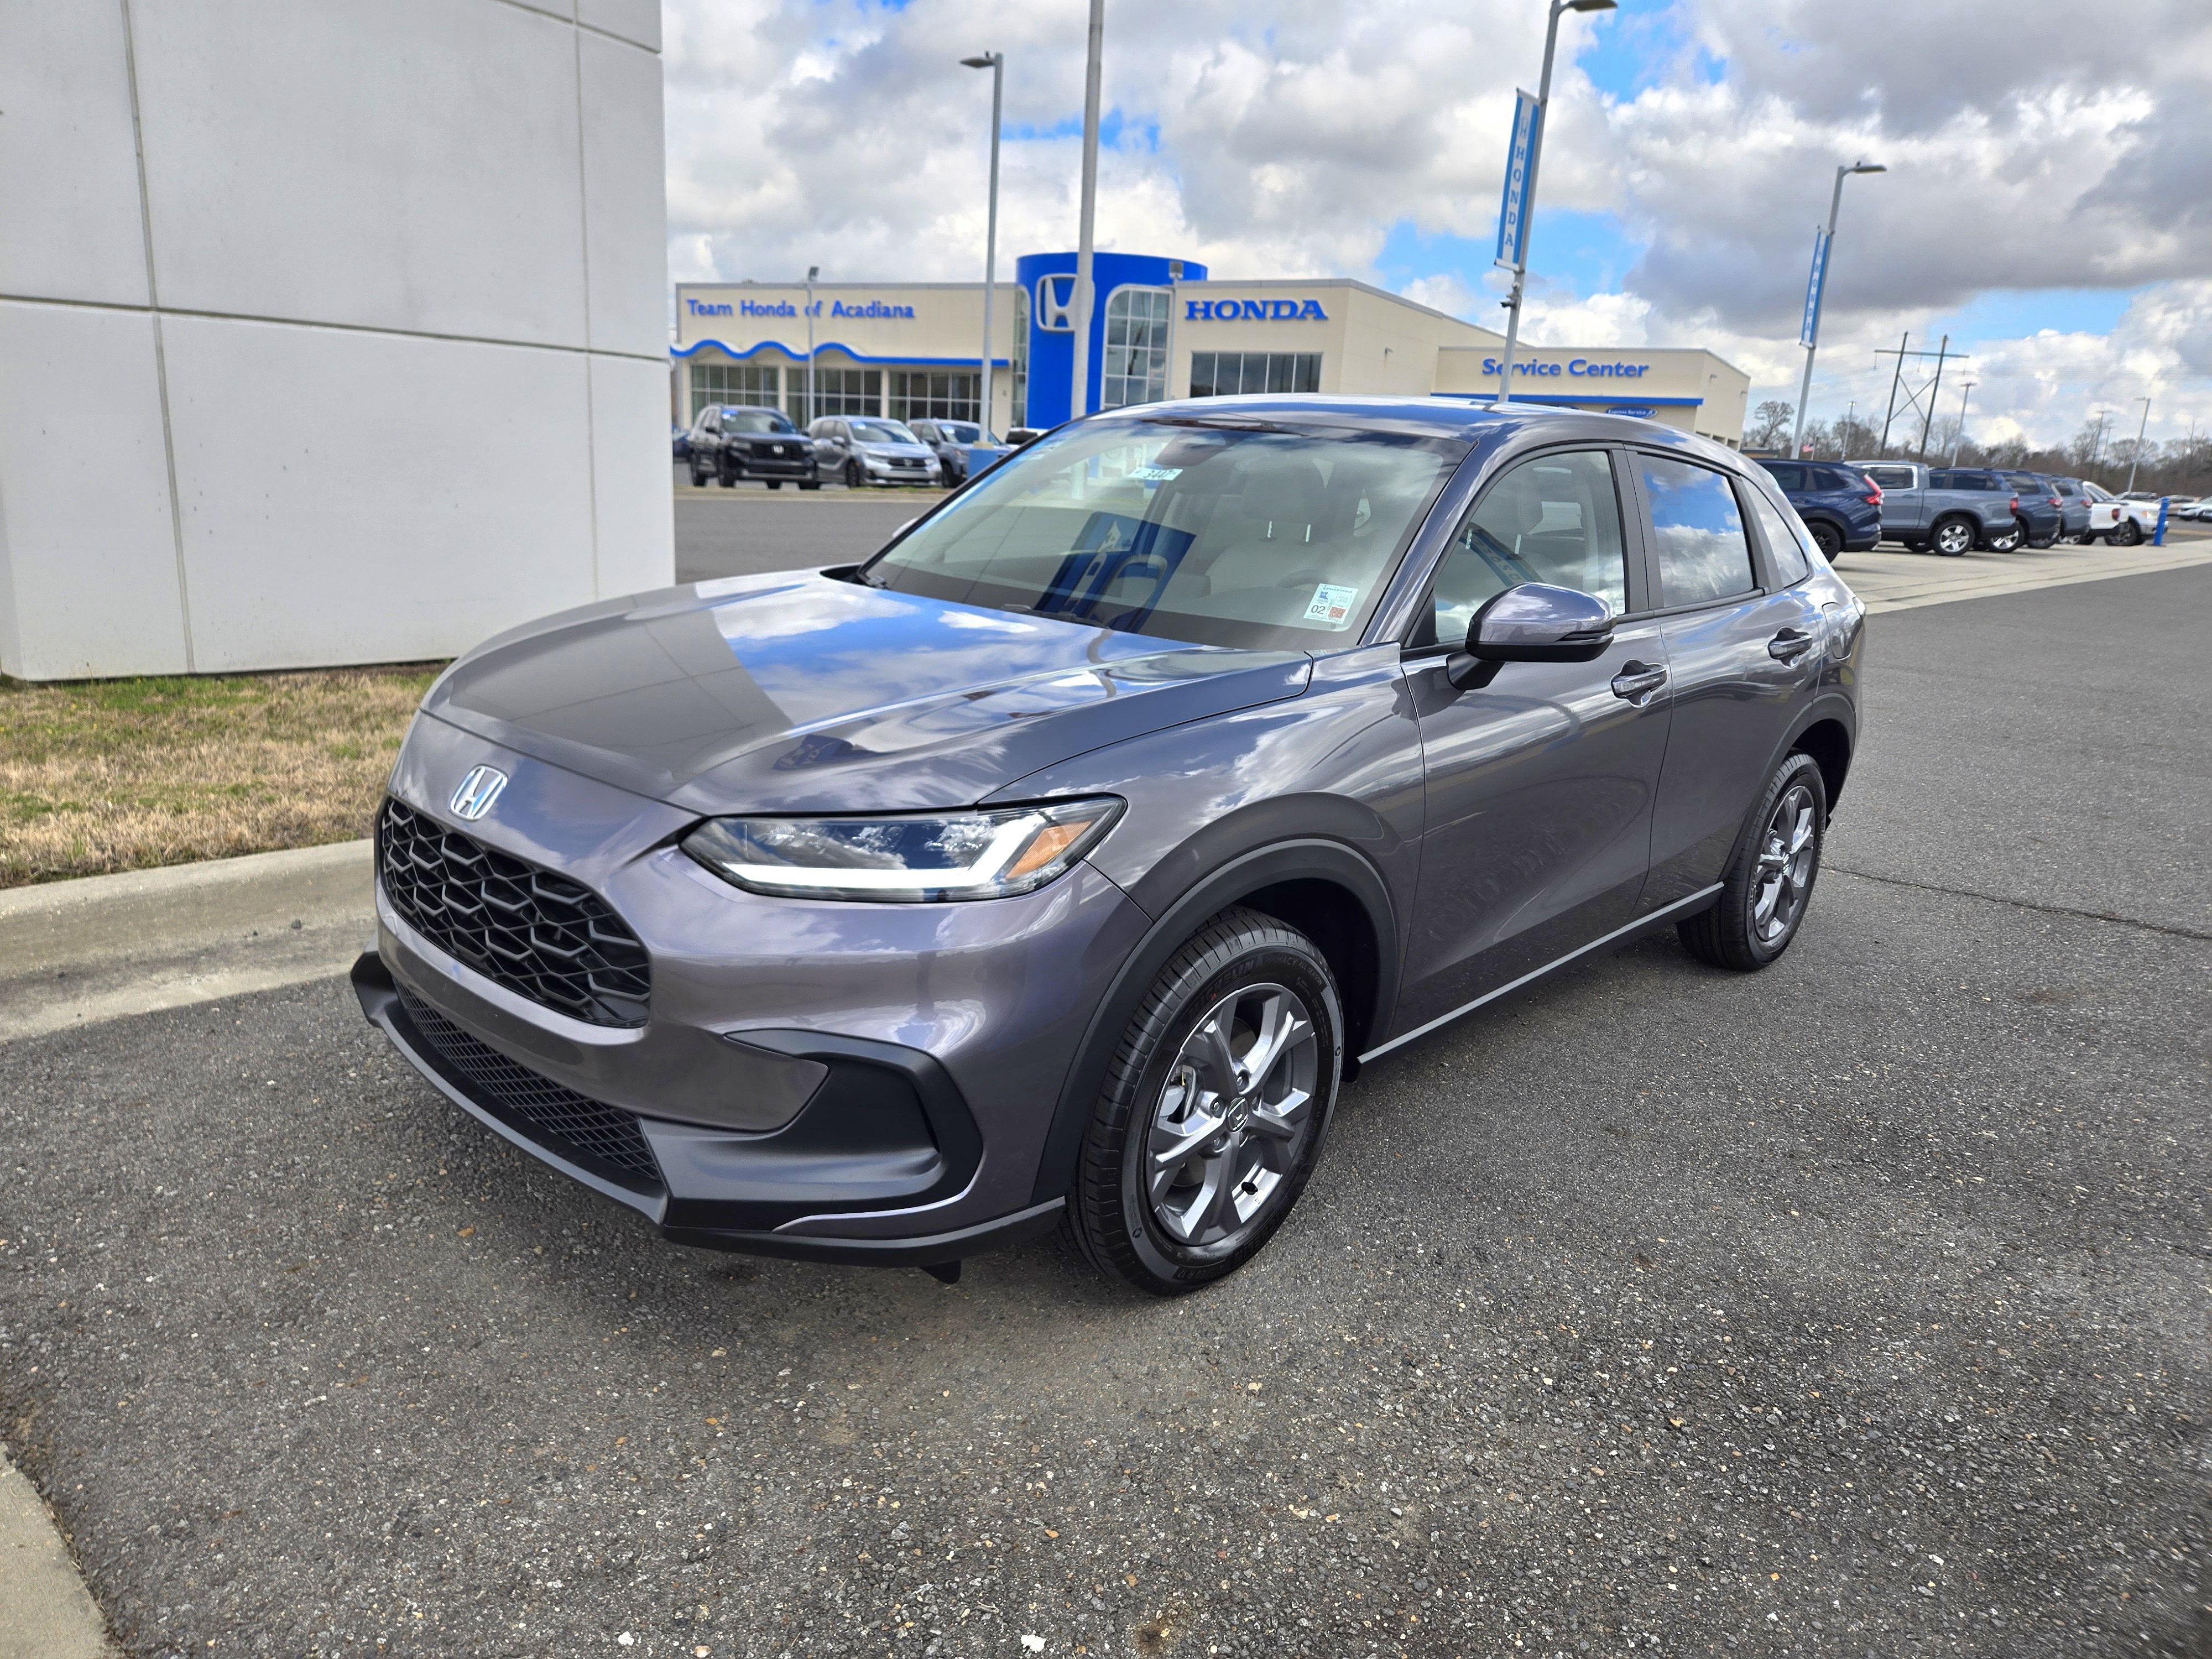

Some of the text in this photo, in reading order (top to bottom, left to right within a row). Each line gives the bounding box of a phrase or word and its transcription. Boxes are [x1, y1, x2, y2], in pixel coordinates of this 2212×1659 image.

[1504, 145, 1525, 247] HONDA
[687, 299, 914, 319] Team Honda of Acadiana
[1185, 299, 1328, 321] HONDA
[1483, 358, 1649, 377] Service Center
[1311, 604, 1326, 615] 02
[1265, 954, 1298, 967] PRIMACY
[1298, 961, 1307, 971] ALL
[1307, 967, 1323, 986] SEASON
